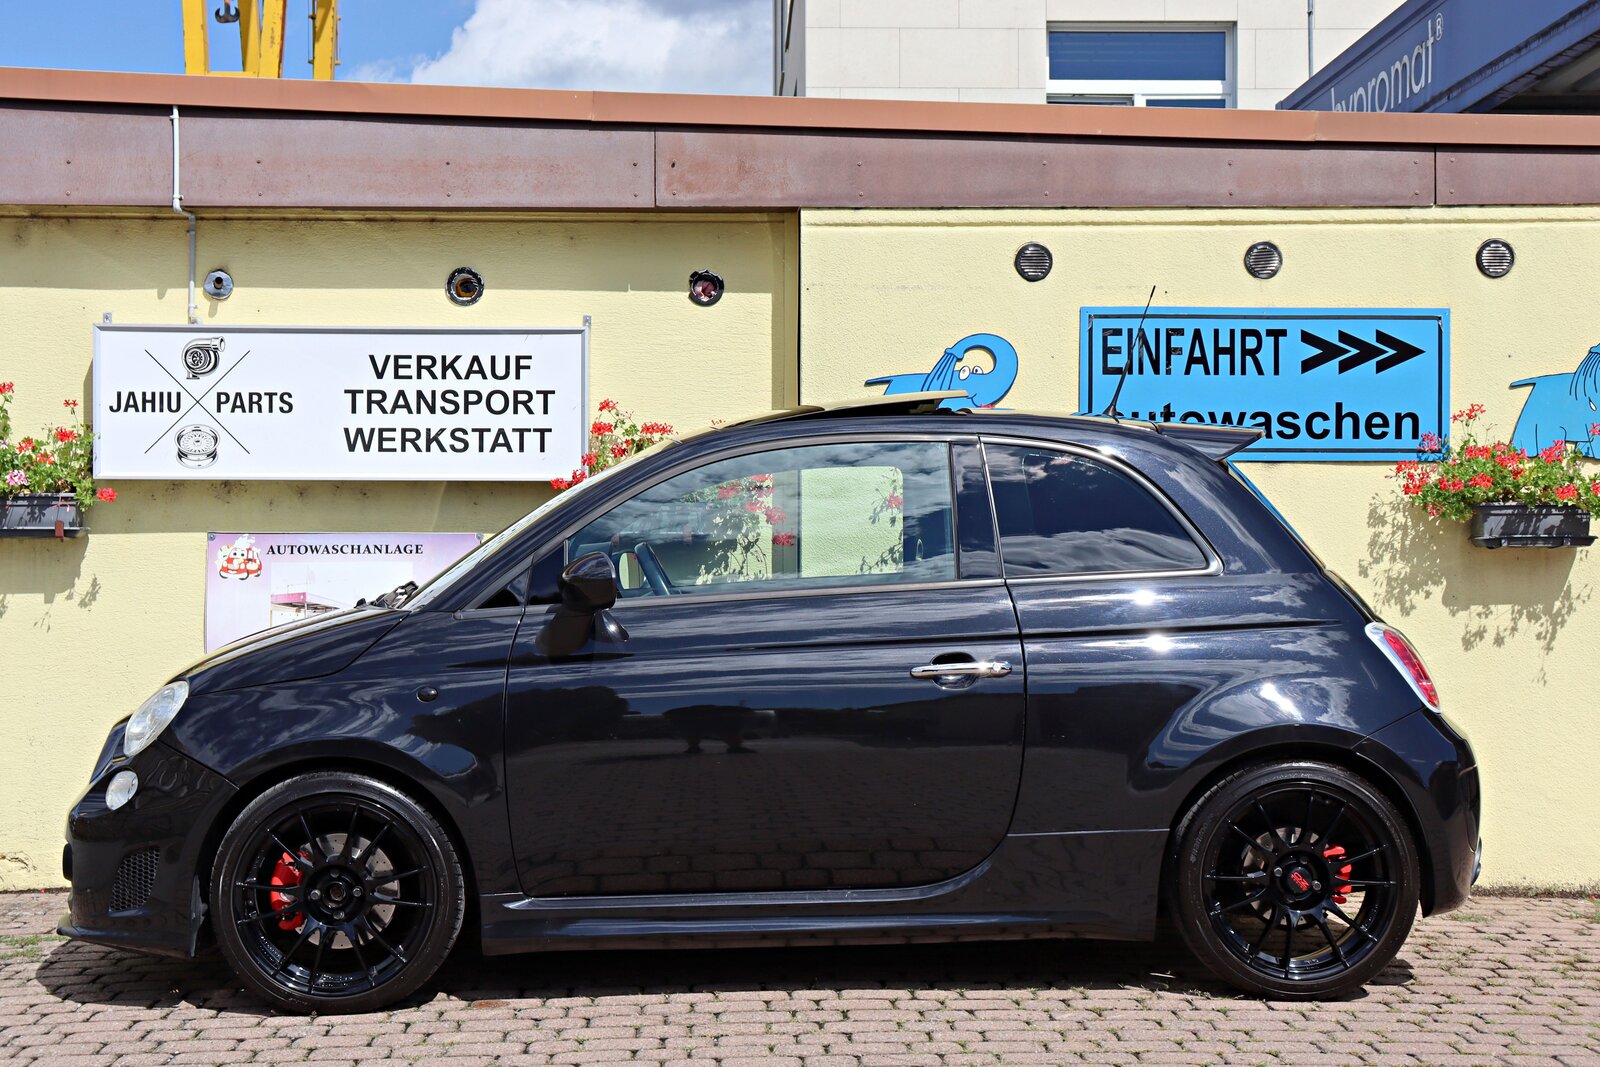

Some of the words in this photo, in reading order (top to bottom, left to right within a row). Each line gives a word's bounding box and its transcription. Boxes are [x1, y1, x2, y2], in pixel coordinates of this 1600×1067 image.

[1101, 328, 1287, 376] EINFAHRT
[368, 354, 533, 380] VERKAUF
[109, 392, 182, 413] JAHIU
[216, 392, 294, 413] PARTS
[344, 389, 556, 415] TRANSPORT
[1113, 402, 1420, 440] twaschen
[343, 427, 553, 453] WERKSTATT
[266, 544, 424, 555] AUTOWASCHANLAGE
